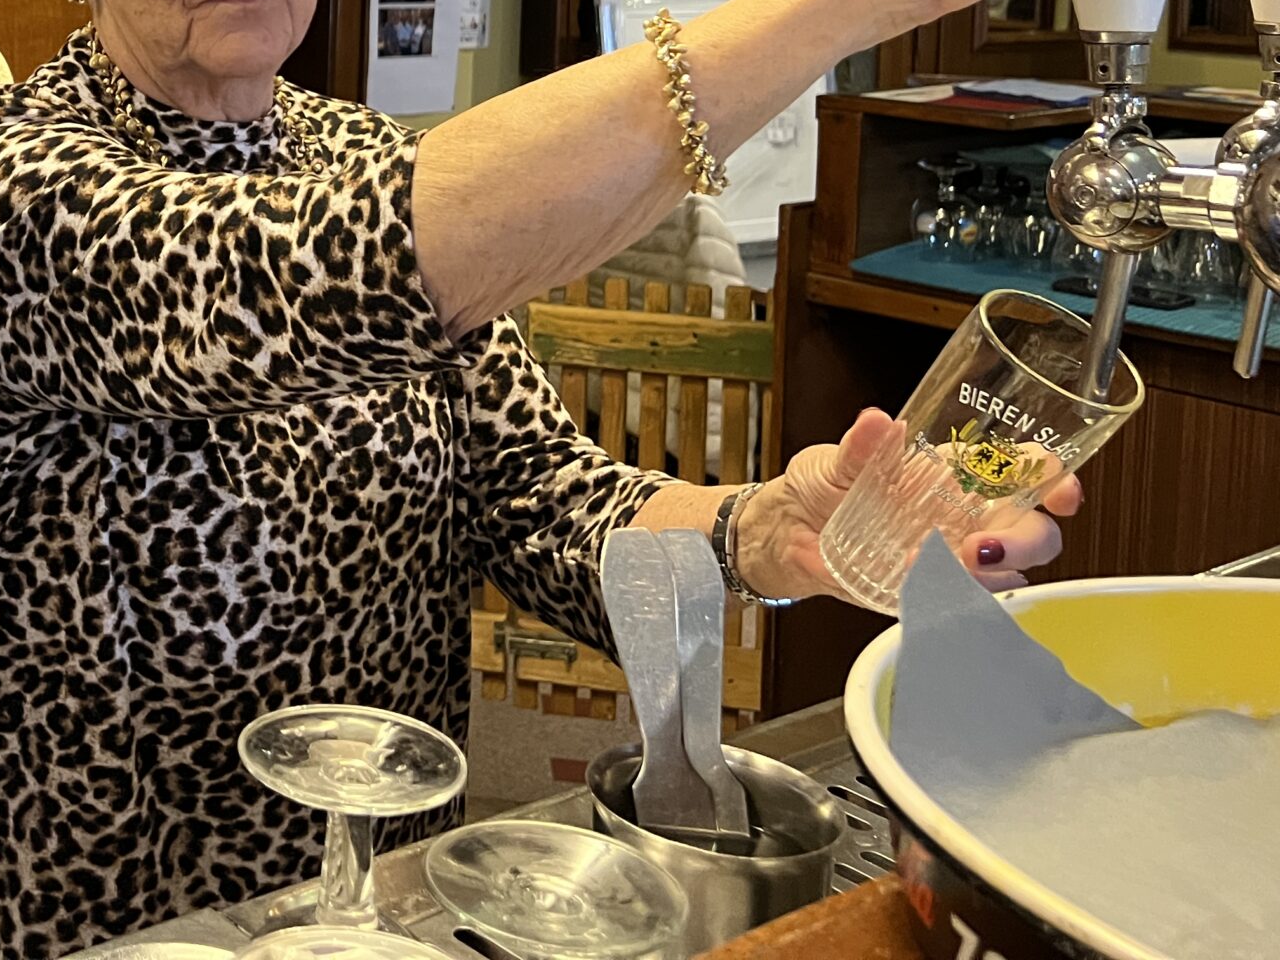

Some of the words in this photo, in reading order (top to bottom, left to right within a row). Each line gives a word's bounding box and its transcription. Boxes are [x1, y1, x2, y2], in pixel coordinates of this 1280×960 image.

[958, 382, 1036, 433] BIEREN
[1033, 426, 1081, 462] SLAG
[929, 484, 982, 517] NINOVE
